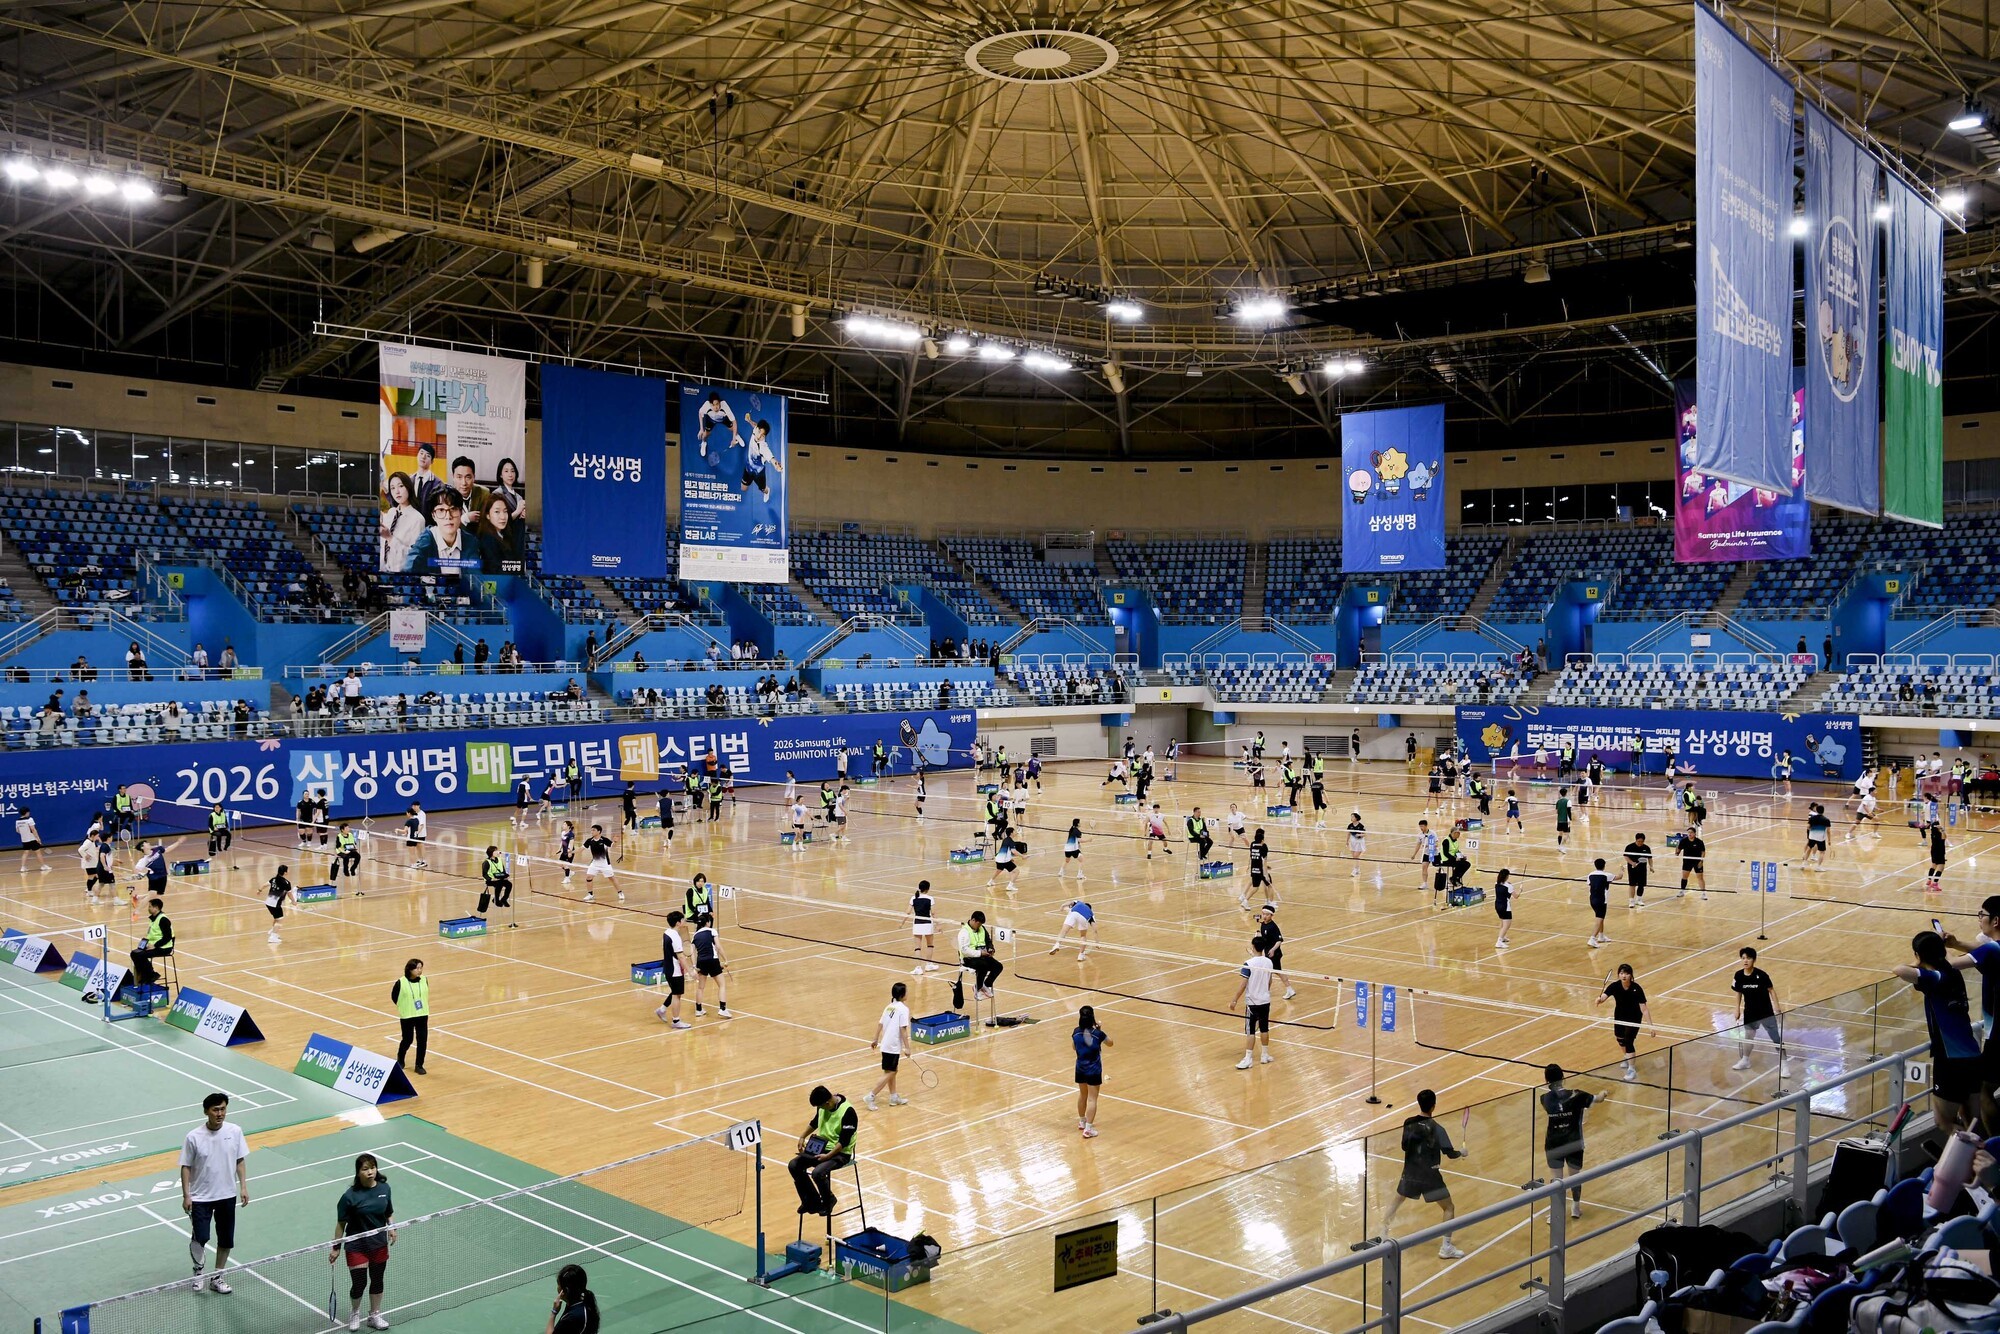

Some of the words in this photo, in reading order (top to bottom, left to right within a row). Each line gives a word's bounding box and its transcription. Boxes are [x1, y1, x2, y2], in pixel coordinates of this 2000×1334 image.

[384, 345, 407, 353] Samsung
[410, 377, 489, 416] 개발자
[489, 406, 511, 419] 입니다
[569, 453, 641, 482] 삼성생명
[685, 480, 697, 489] 믿고
[685, 490, 697, 498] 연금
[698, 491, 721, 500] 파트너가
[1368, 514, 1416, 531] 삼성생명
[685, 530, 716, 540] 연금LAB
[1698, 531, 1730, 539] Samsung
[1710, 539, 1748, 550] Badminton
[592, 554, 621, 563] Samsung
[950, 714, 971, 723] 삼성생명
[1824, 721, 1853, 730] 삼성생명
[773, 740, 794, 749] 2026
[795, 738, 831, 749] Samsung
[833, 737, 846, 746] Life
[1527, 733, 1575, 749] 보험을
[1646, 737, 1680, 754] 보험
[1685, 729, 1772, 757] 삼성생명
[774, 749, 828, 761] BADMINTON
[830, 747, 864, 758] FESIVAL
[175, 763, 279, 806] 2026
[297, 747, 458, 802] 삼성생명
[471, 739, 614, 785] 배드민턴
[624, 732, 750, 774] 페스티벌
[721, 888, 729, 897] 10
[88, 928, 102, 939] 10
[1000, 931, 1005, 940] 9
[21, 944, 43, 962] 삼성생명
[74, 964, 92, 980] YONEX
[183, 1002, 204, 1020] YONEX
[204, 1009, 235, 1033] 삼성생명
[947, 1025, 965, 1035] YONEX
[316, 1050, 342, 1072] YONEX
[345, 1060, 386, 1089] 삼성생명
[736, 1126, 756, 1146] 10
[40, 1141, 138, 1165] YONEX
[36, 1190, 144, 1218] YONEX
[858, 1260, 886, 1280] YONEX
